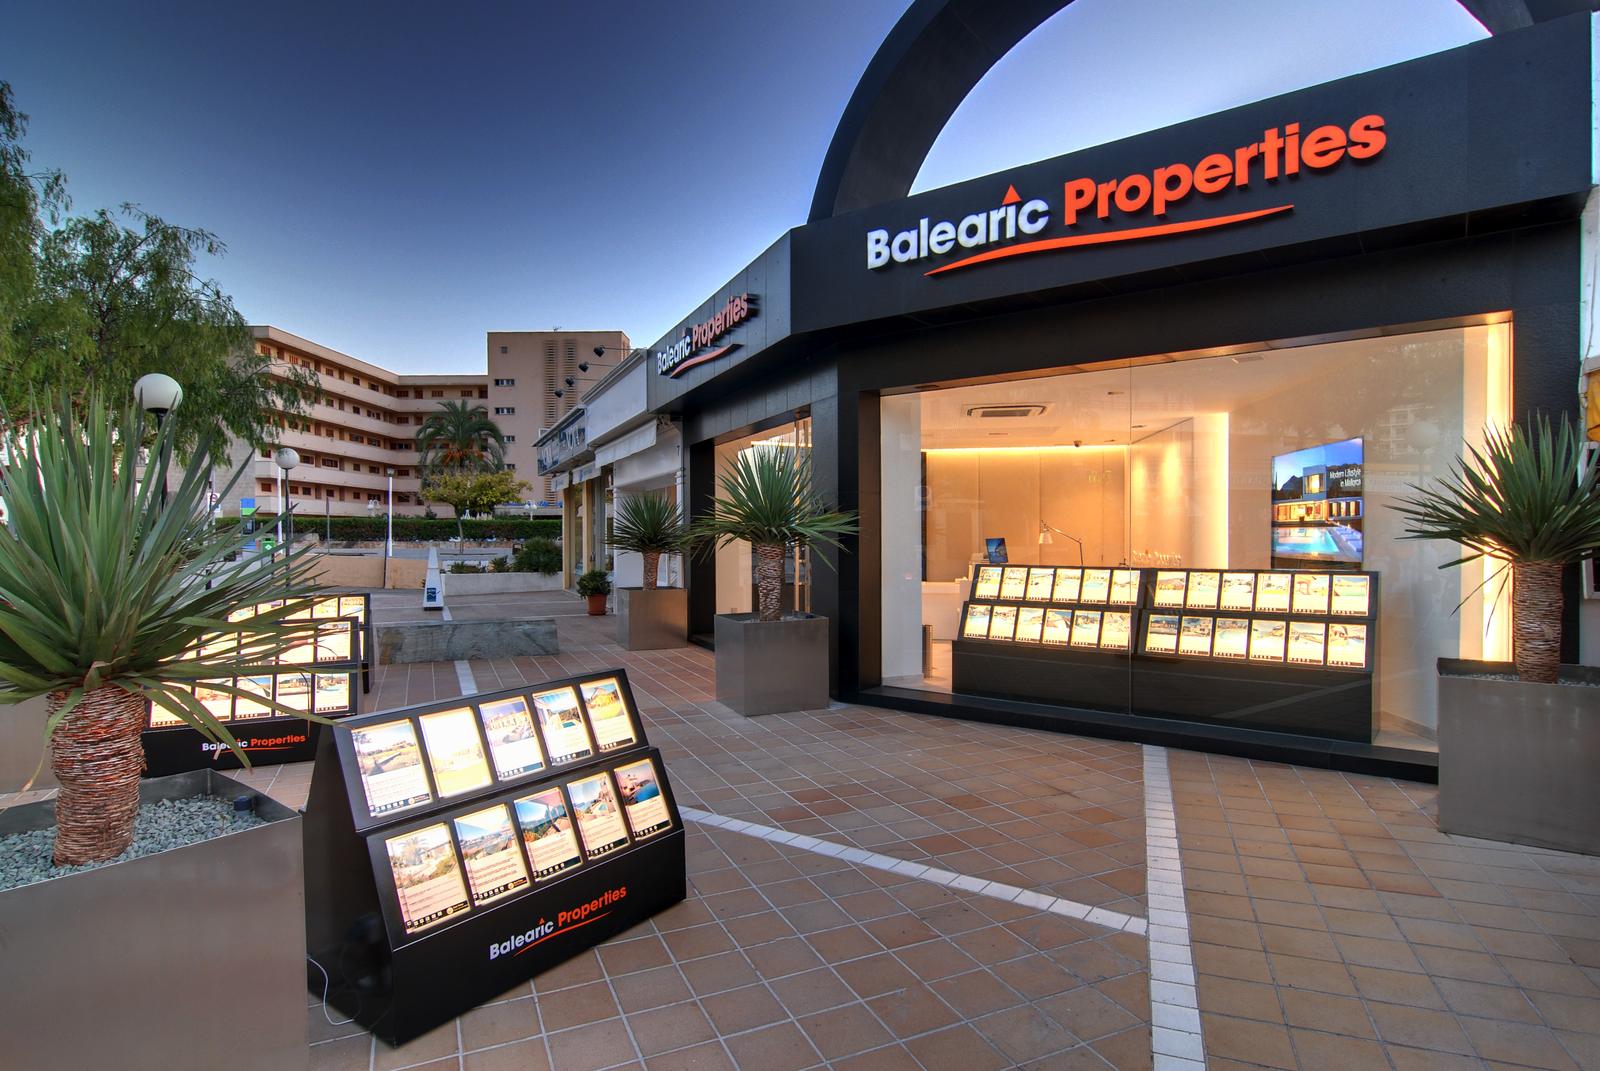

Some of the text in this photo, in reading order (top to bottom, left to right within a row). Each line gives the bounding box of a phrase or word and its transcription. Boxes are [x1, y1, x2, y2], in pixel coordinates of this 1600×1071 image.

[866, 113, 1388, 270] Balearic Properties
[656, 292, 748, 375] Balearic Properties
[201, 734, 306, 751] Baleic Properties
[489, 885, 628, 960] Balearic Properties
